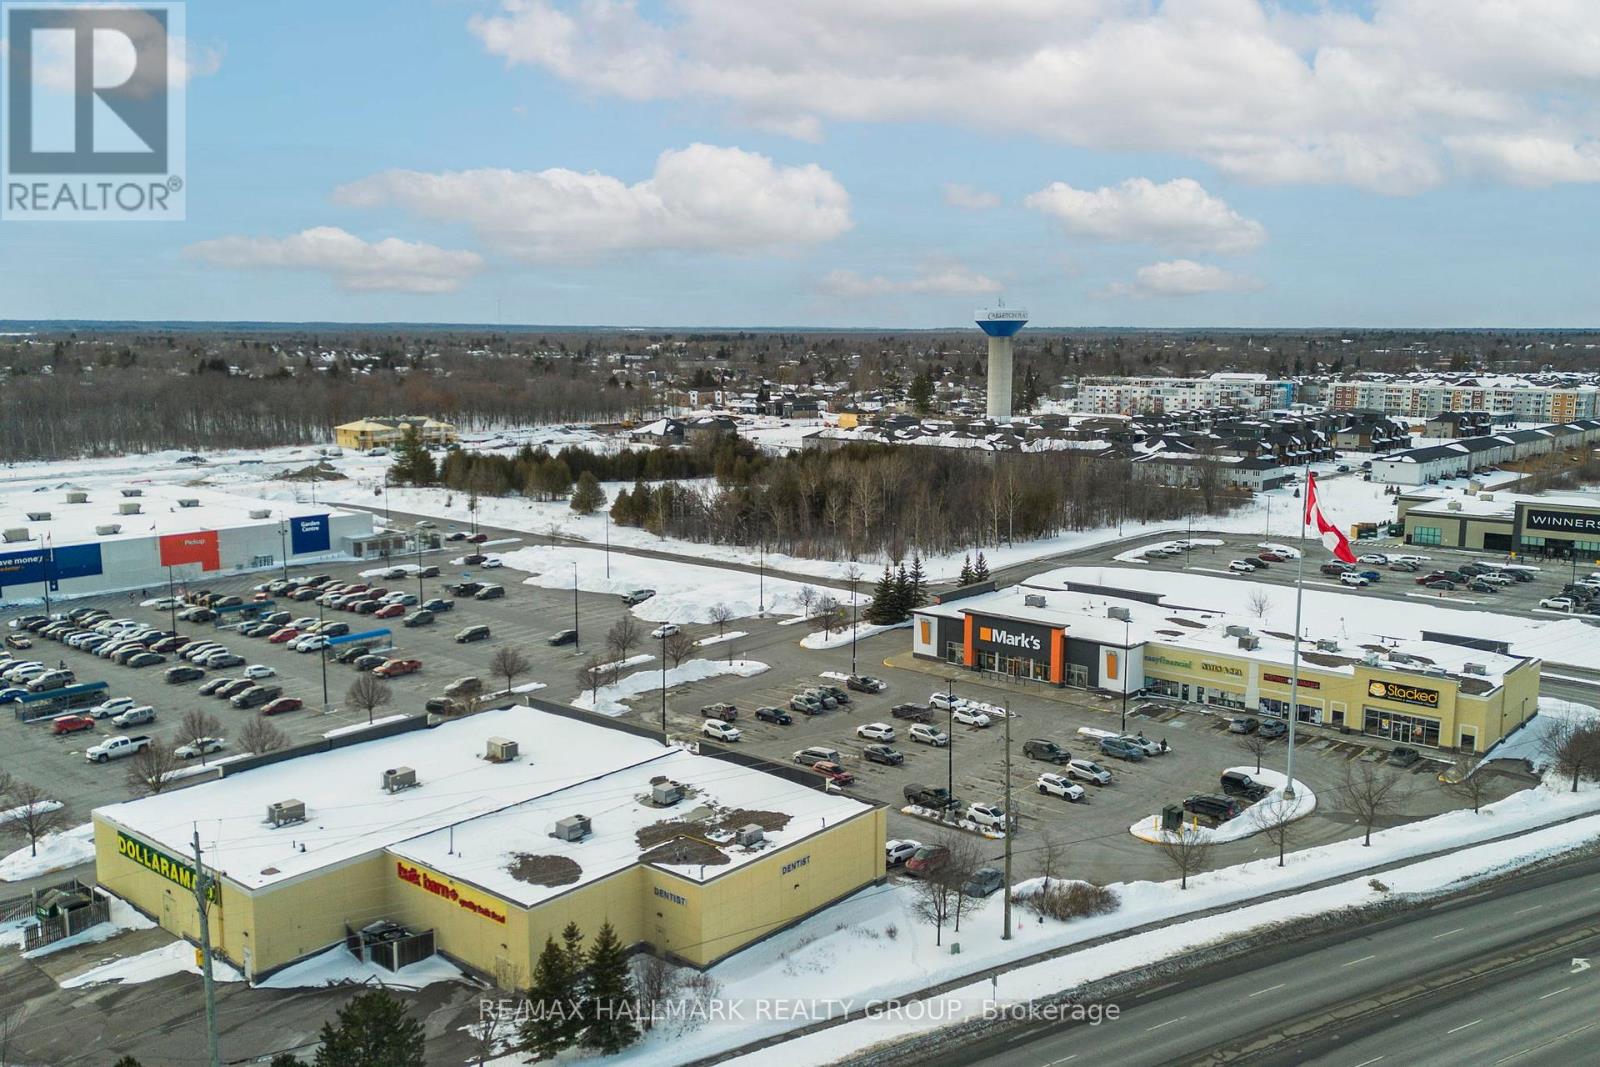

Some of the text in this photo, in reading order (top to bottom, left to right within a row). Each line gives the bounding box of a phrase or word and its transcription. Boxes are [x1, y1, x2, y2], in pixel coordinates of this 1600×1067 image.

[992, 629, 1041, 650] Mark's
[1388, 684, 1438, 703] Stacked
[782, 855, 811, 875] DENTIST
[654, 887, 686, 905] DENTIST
